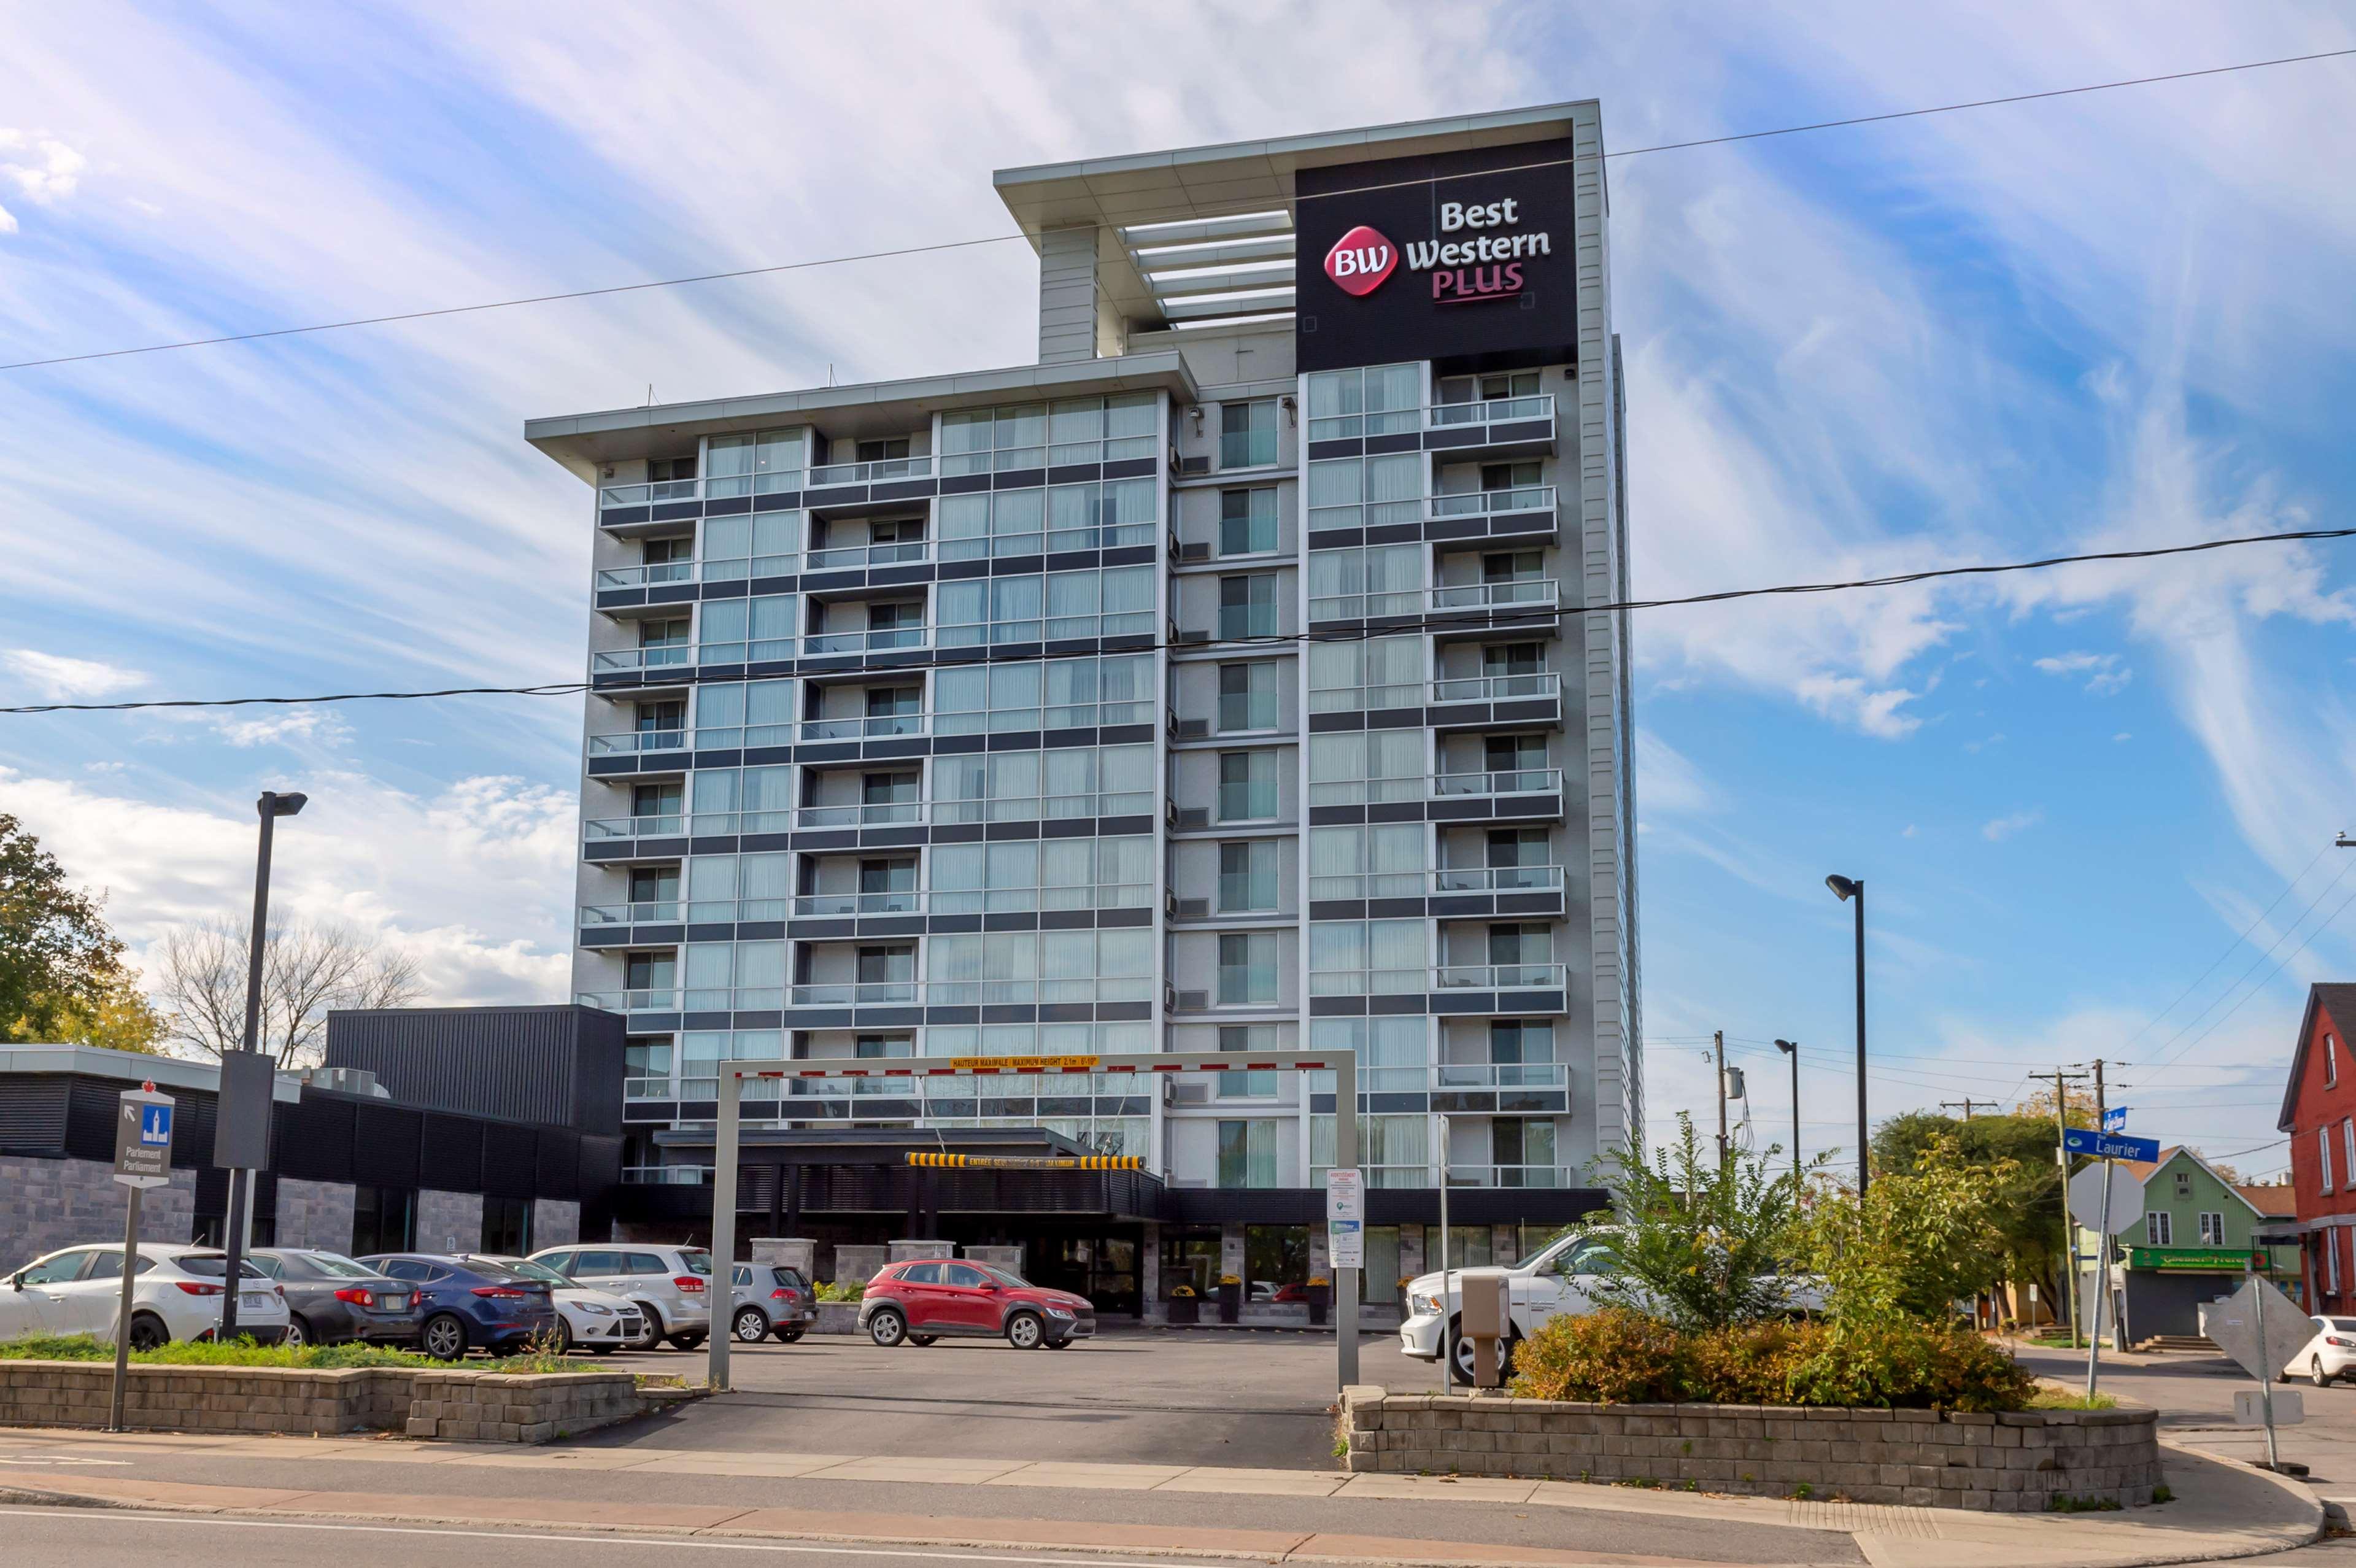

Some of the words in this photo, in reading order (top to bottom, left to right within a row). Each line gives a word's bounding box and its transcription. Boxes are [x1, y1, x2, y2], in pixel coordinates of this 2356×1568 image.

[1442, 198, 1518, 232] Best
[1335, 245, 1388, 277] BW
[1405, 232, 1551, 271] Western
[1433, 262, 1523, 299] PLUS
[1040, 1057, 1060, 1066] HEIGHT
[2096, 1140, 2141, 1157] Laurier
[123, 1160, 161, 1173] Parliament
